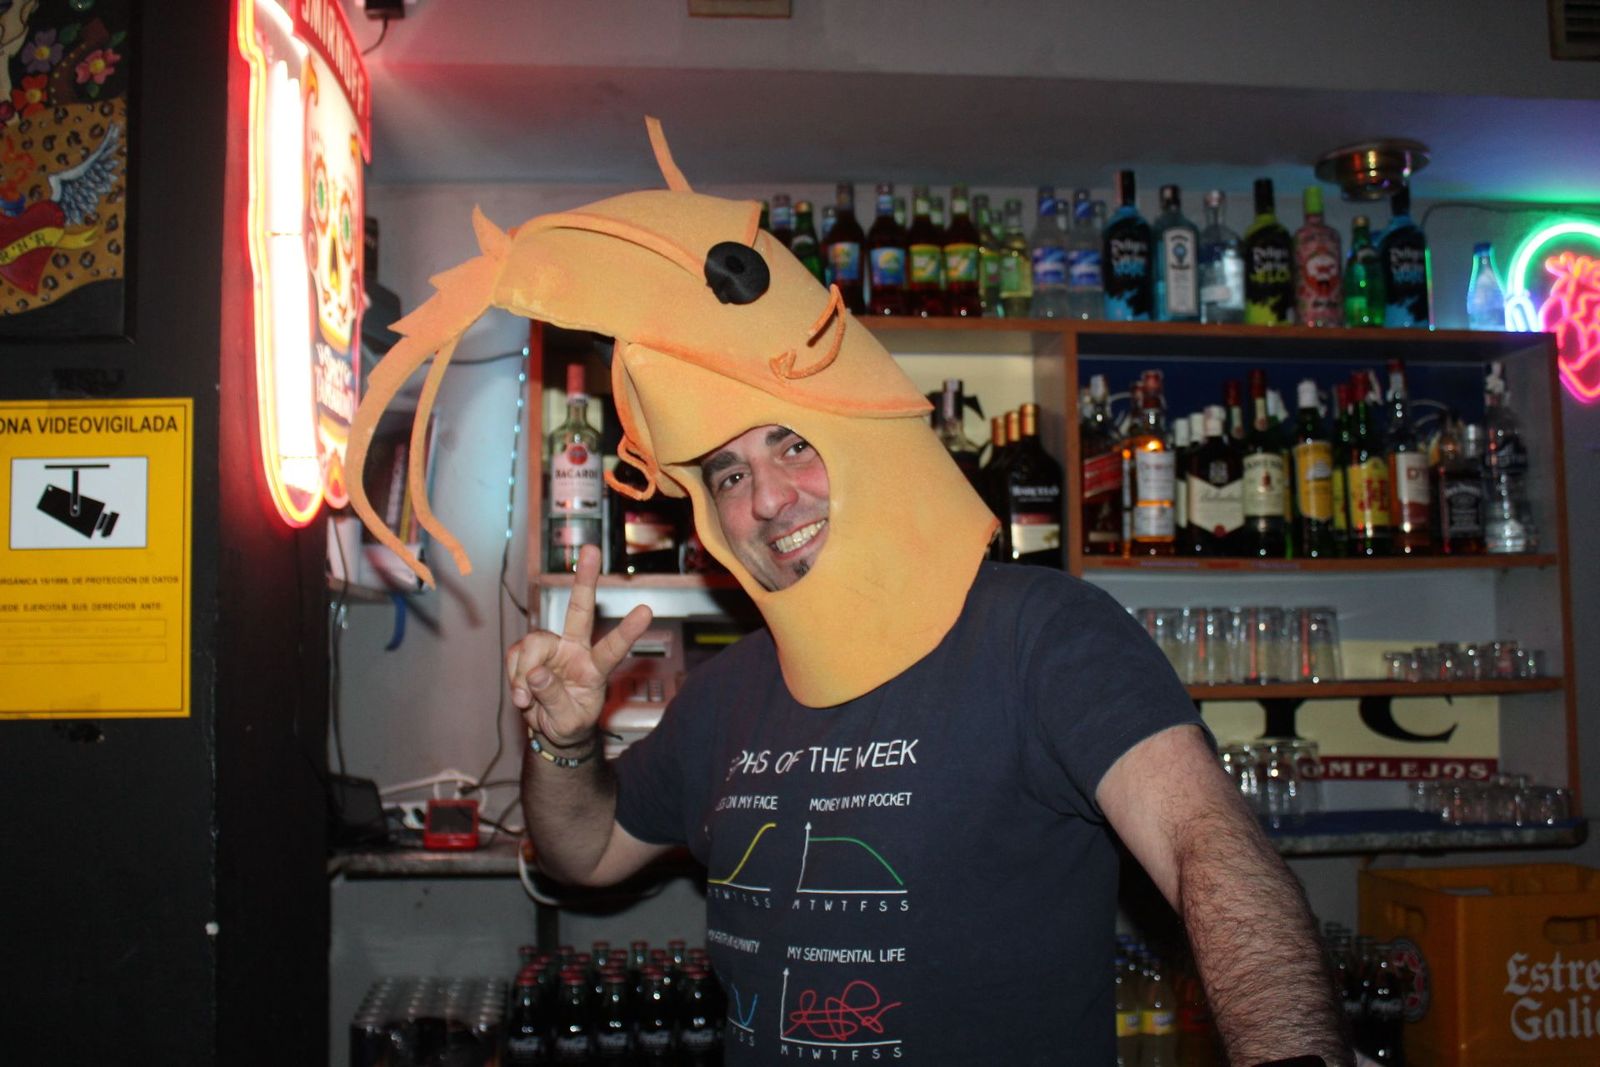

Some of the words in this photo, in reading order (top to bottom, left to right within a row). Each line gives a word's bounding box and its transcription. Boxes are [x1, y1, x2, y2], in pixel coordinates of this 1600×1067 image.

[37, 415, 178, 434] VIDEOVIGILADA
[555, 469, 598, 479] BACARDI
[152, 575, 179, 584] DATOS
[775, 750, 804, 774] OF
[809, 747, 852, 773] THE
[856, 739, 919, 770] WEEK
[737, 795, 753, 809] MY
[753, 795, 779, 811] FACE
[809, 798, 840, 812] MONEY
[840, 796, 851, 810] IN
[850, 794, 867, 809] MY
[867, 792, 913, 808] POCKET
[764, 898, 772, 909] S
[810, 899, 816, 911] T
[824, 900, 833, 911] W
[841, 900, 848, 912] T
[861, 900, 868, 912] F
[879, 900, 888, 912] S
[900, 899, 909, 911] S
[787, 945, 802, 960] MY
[803, 947, 875, 963] SENTIMENTAL
[879, 947, 906, 963] LIFE
[781, 1044, 789, 1056] M
[811, 1049, 821, 1060] W
[831, 1049, 838, 1060] T
[851, 1050, 859, 1061] F
[872, 1048, 881, 1060] S
[893, 1046, 903, 1058] S
